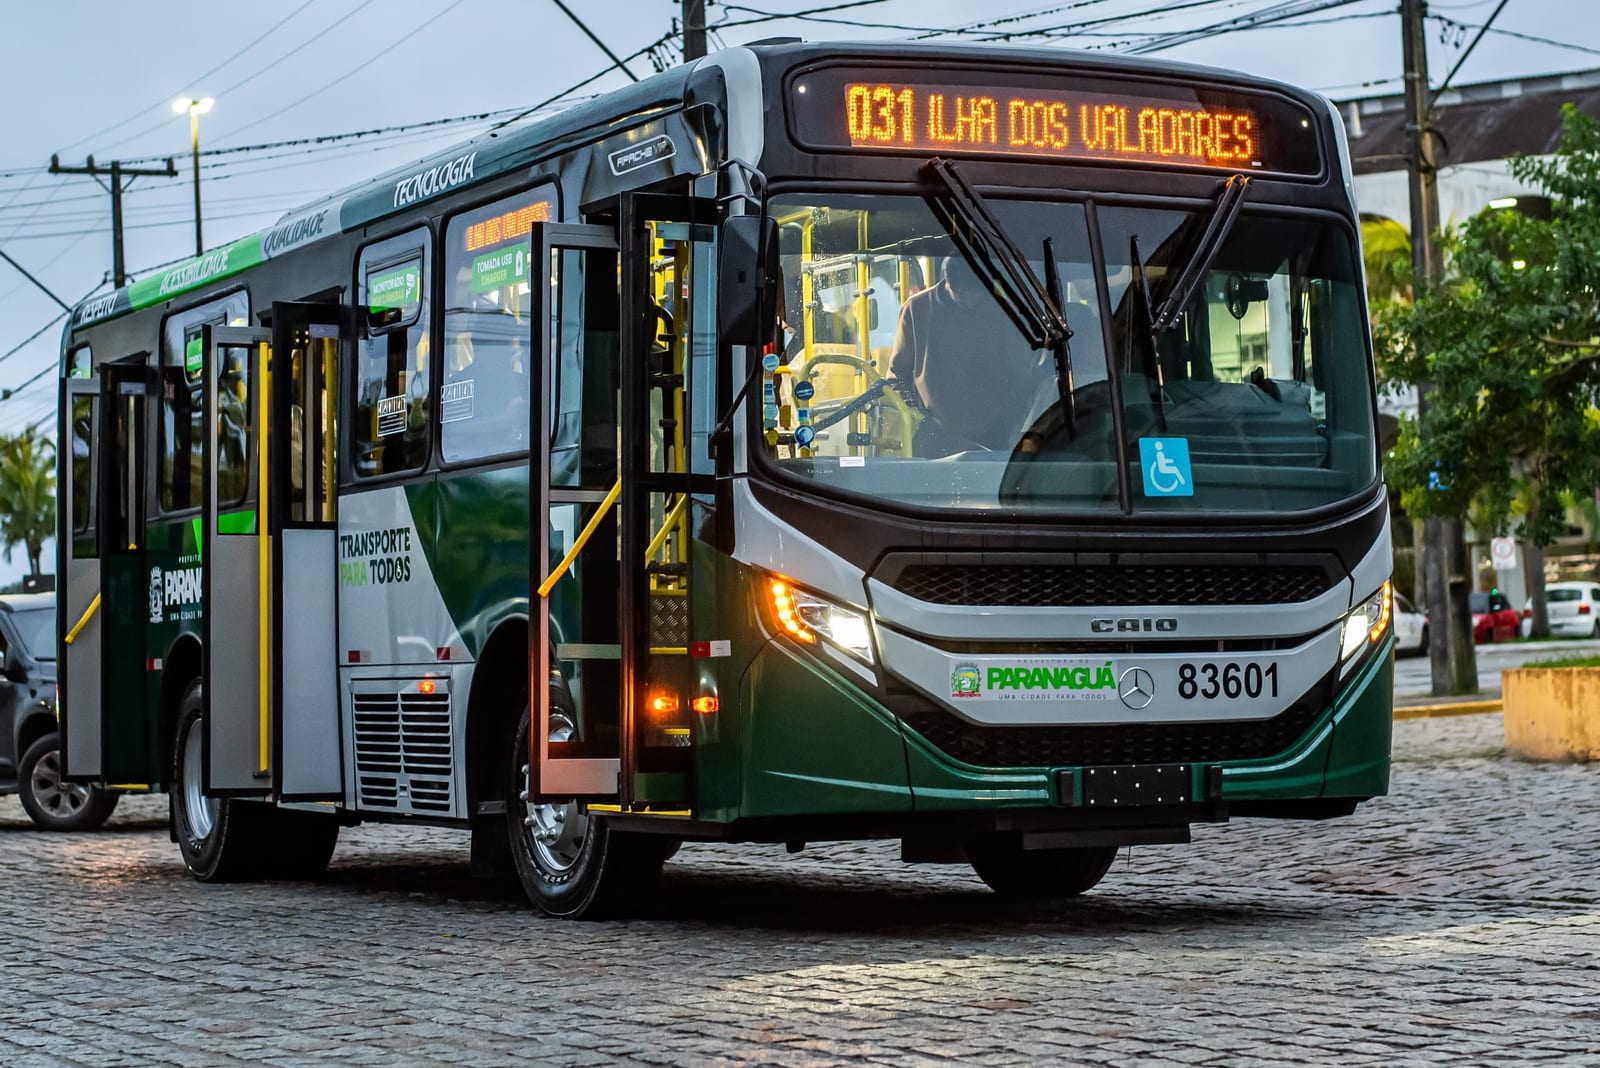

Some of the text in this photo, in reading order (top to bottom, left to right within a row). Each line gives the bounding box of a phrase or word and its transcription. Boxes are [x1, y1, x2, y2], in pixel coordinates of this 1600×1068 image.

[849, 85, 913, 144] 031
[928, 94, 1252, 161] ILHA DOS VALADARES
[616, 146, 653, 168] APACHE
[393, 152, 475, 208] TECNOLOGIA
[263, 209, 328, 251] QUALIDADE
[159, 248, 232, 295] ACESSIBILIDADE
[477, 253, 513, 272] TOMADA USB
[373, 276, 404, 294] MONITORADO
[80, 293, 119, 325] RESPEITO
[340, 527, 411, 559] TRANSPORTE
[340, 555, 411, 588] PARA TODOS
[169, 612, 179, 621] UMA
[180, 610, 196, 621] CIDADE
[1091, 618, 1178, 632] CAIO
[987, 661, 1116, 690] PARANAGUÁ
[1178, 661, 1278, 700] 83601
